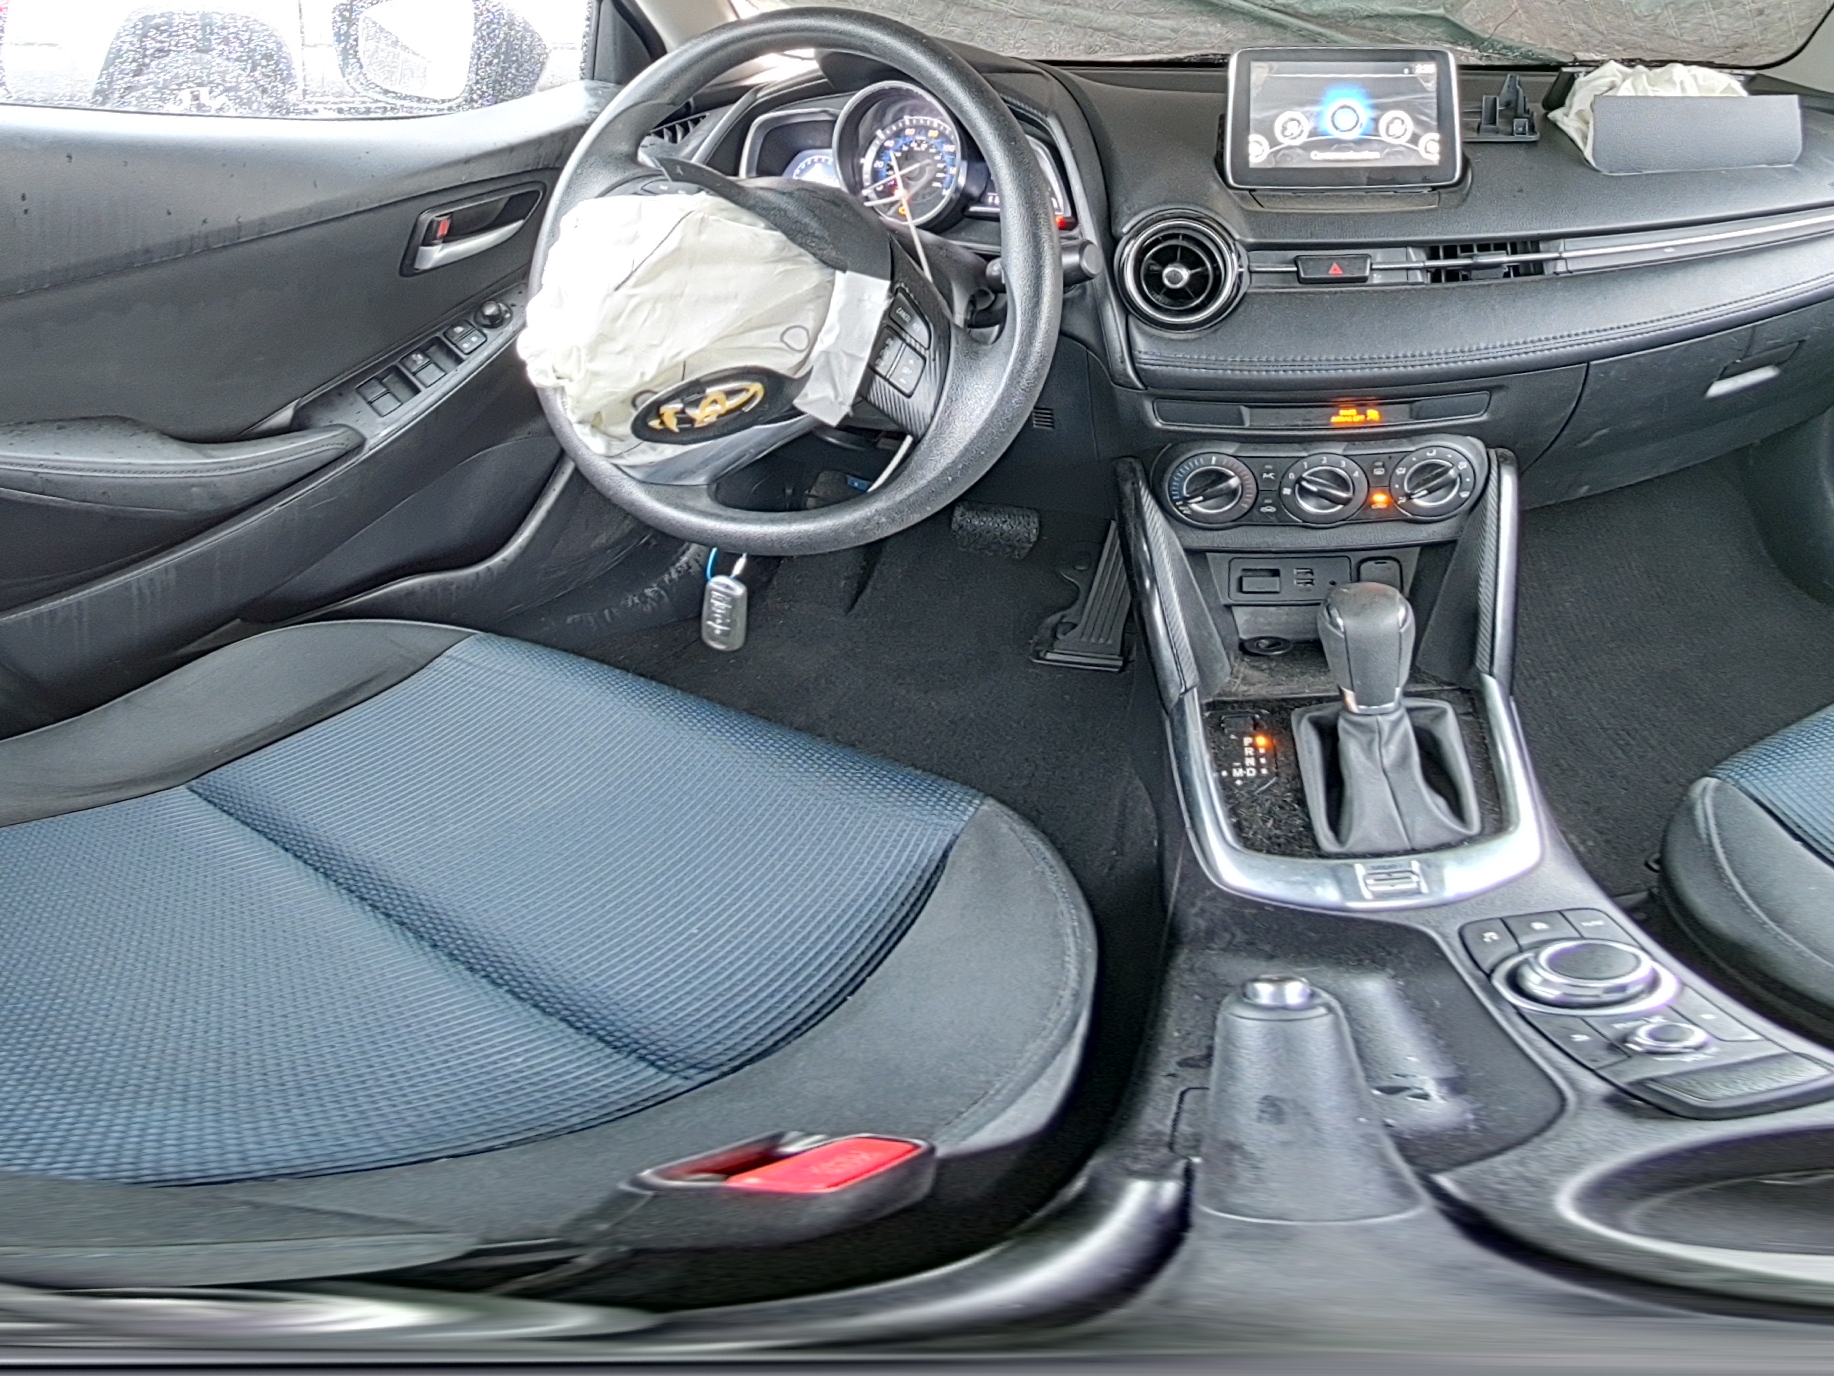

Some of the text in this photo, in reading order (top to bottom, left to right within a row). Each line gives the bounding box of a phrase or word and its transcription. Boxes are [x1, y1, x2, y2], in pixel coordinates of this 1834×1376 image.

[1243, 737, 1253, 746] P
[1244, 747, 1254, 756] R
[1245, 757, 1255, 766] N
